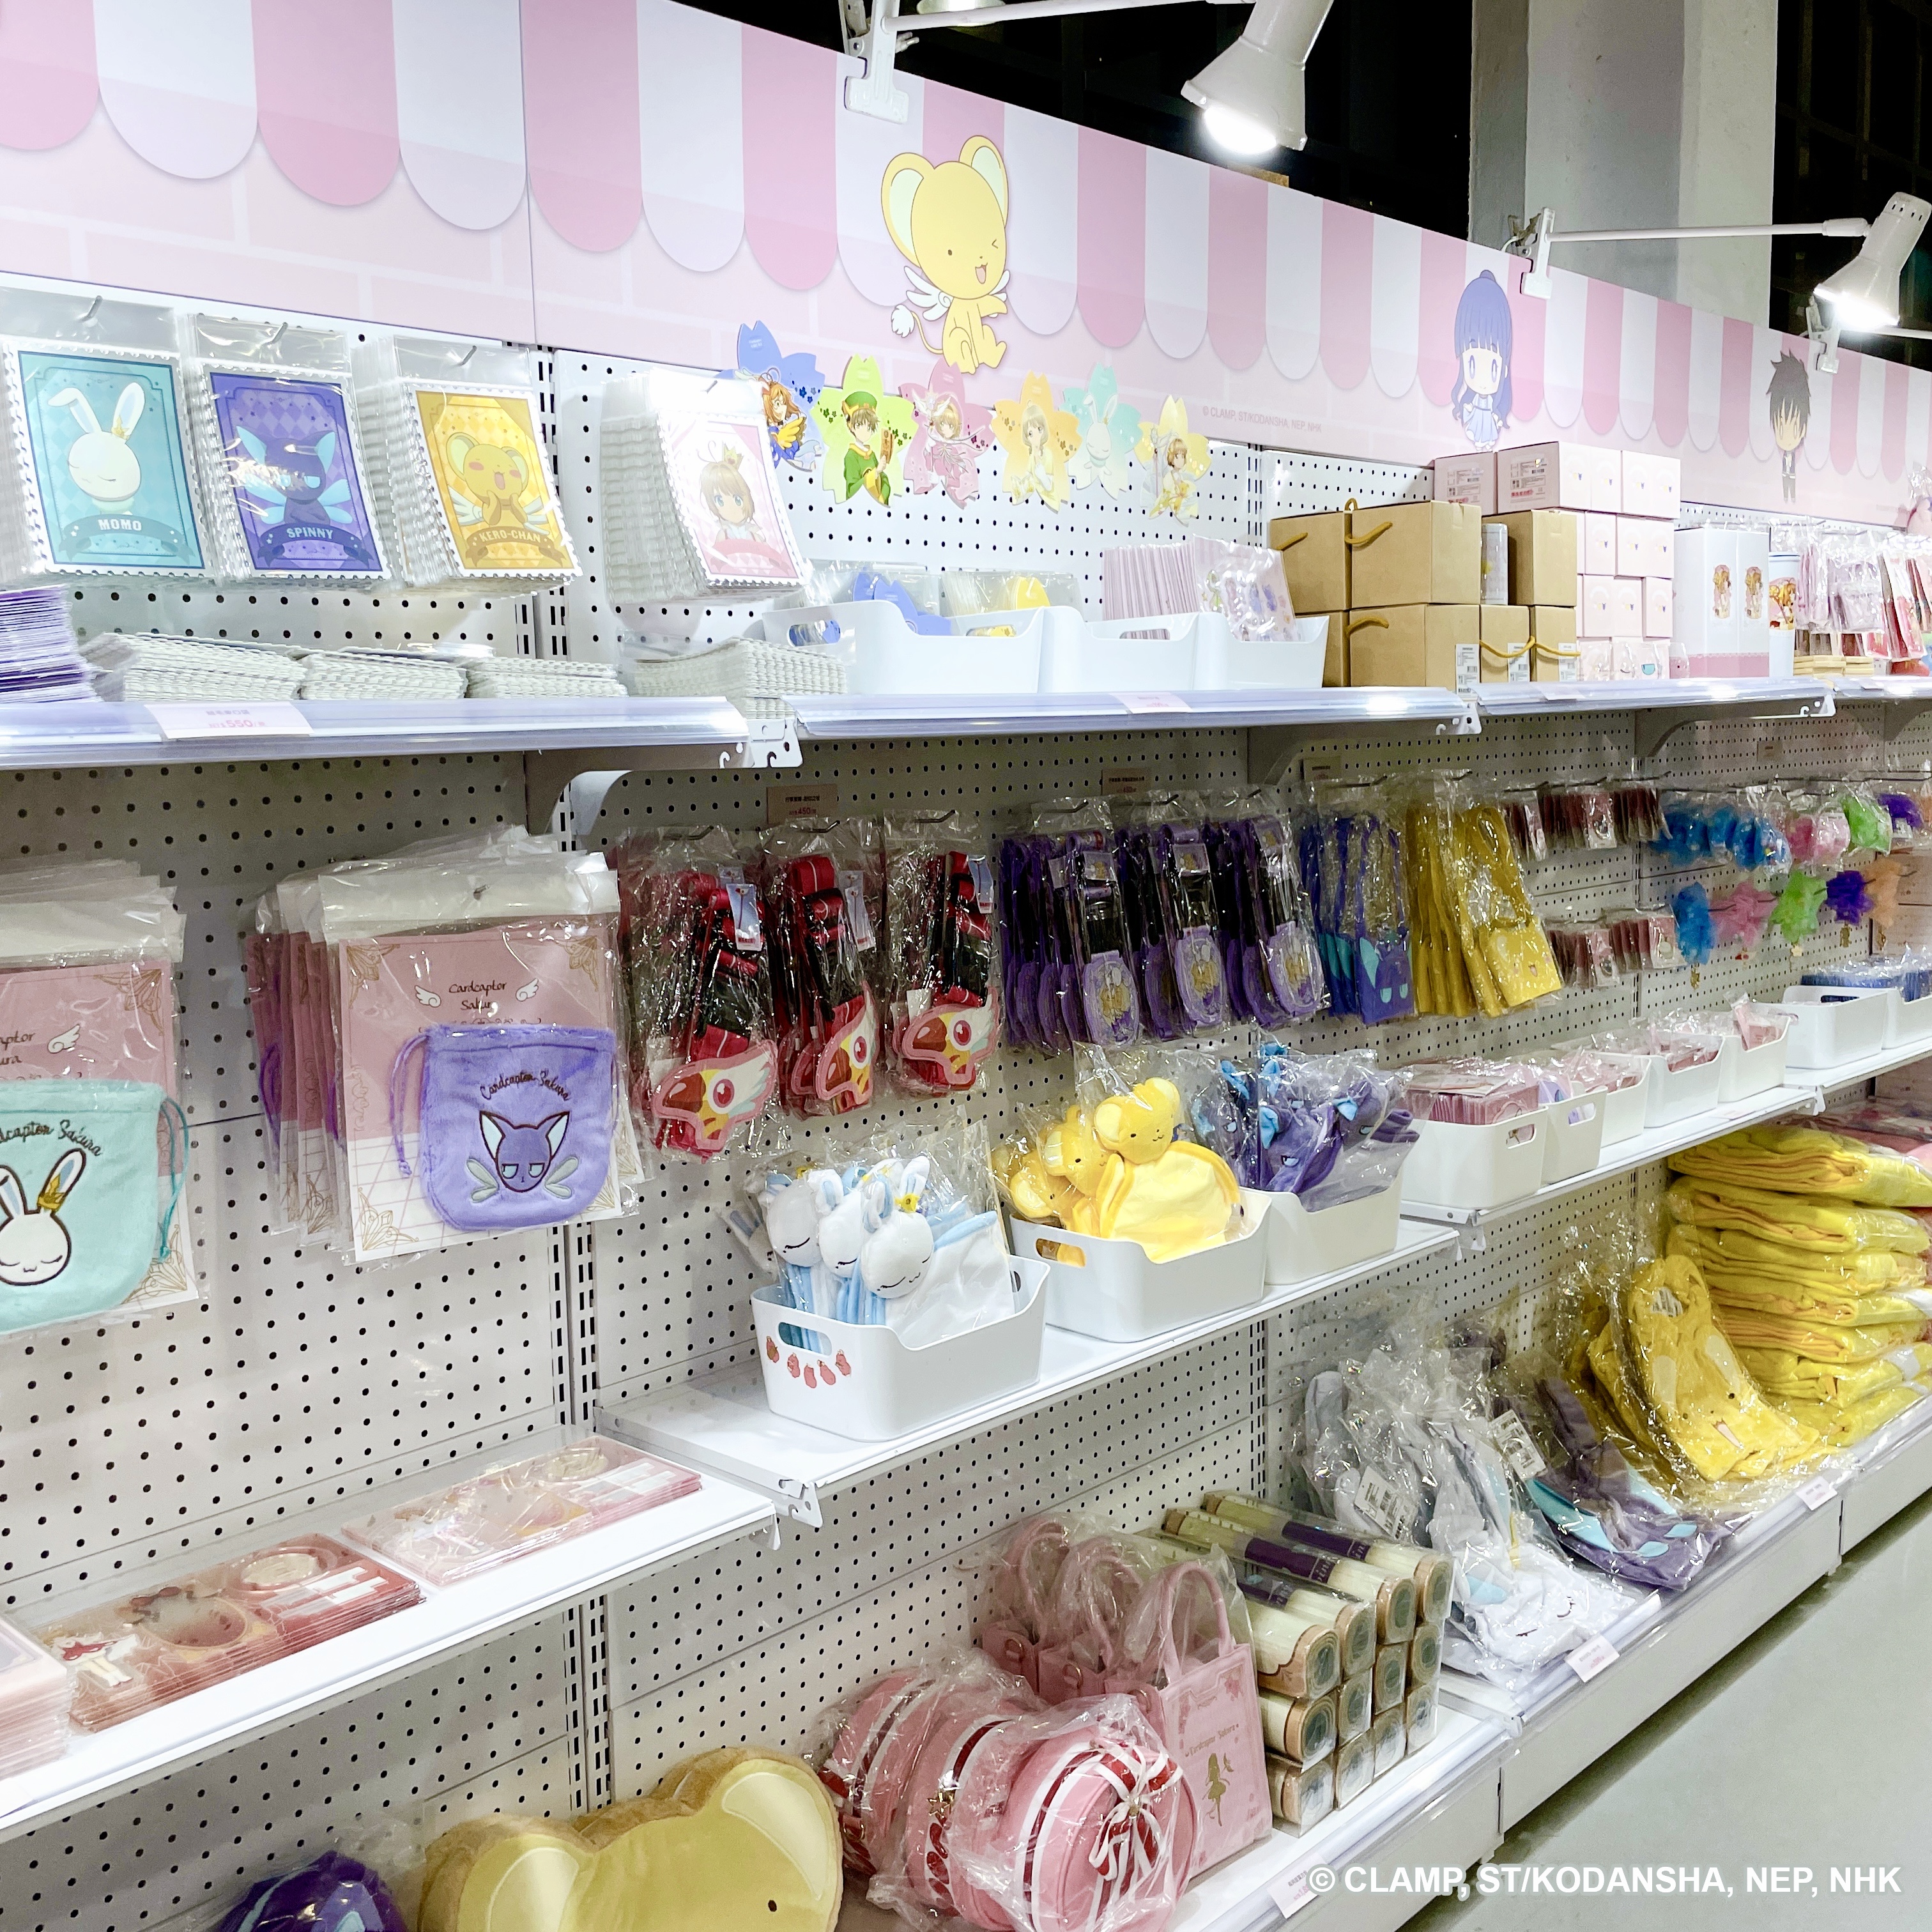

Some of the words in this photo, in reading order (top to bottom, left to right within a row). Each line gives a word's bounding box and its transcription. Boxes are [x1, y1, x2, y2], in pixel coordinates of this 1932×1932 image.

[1211, 407, 1236, 422] CLAMP,
[1308, 422, 1322, 433] NHK
[98, 519, 142, 531] MOMO
[286, 526, 334, 539] SPINNY
[479, 529, 541, 543] KERO-CHAN
[448, 980, 507, 997] Cardcaptor
[460, 997, 498, 1011] Sakur
[57, 1119, 103, 1157] Sakura
